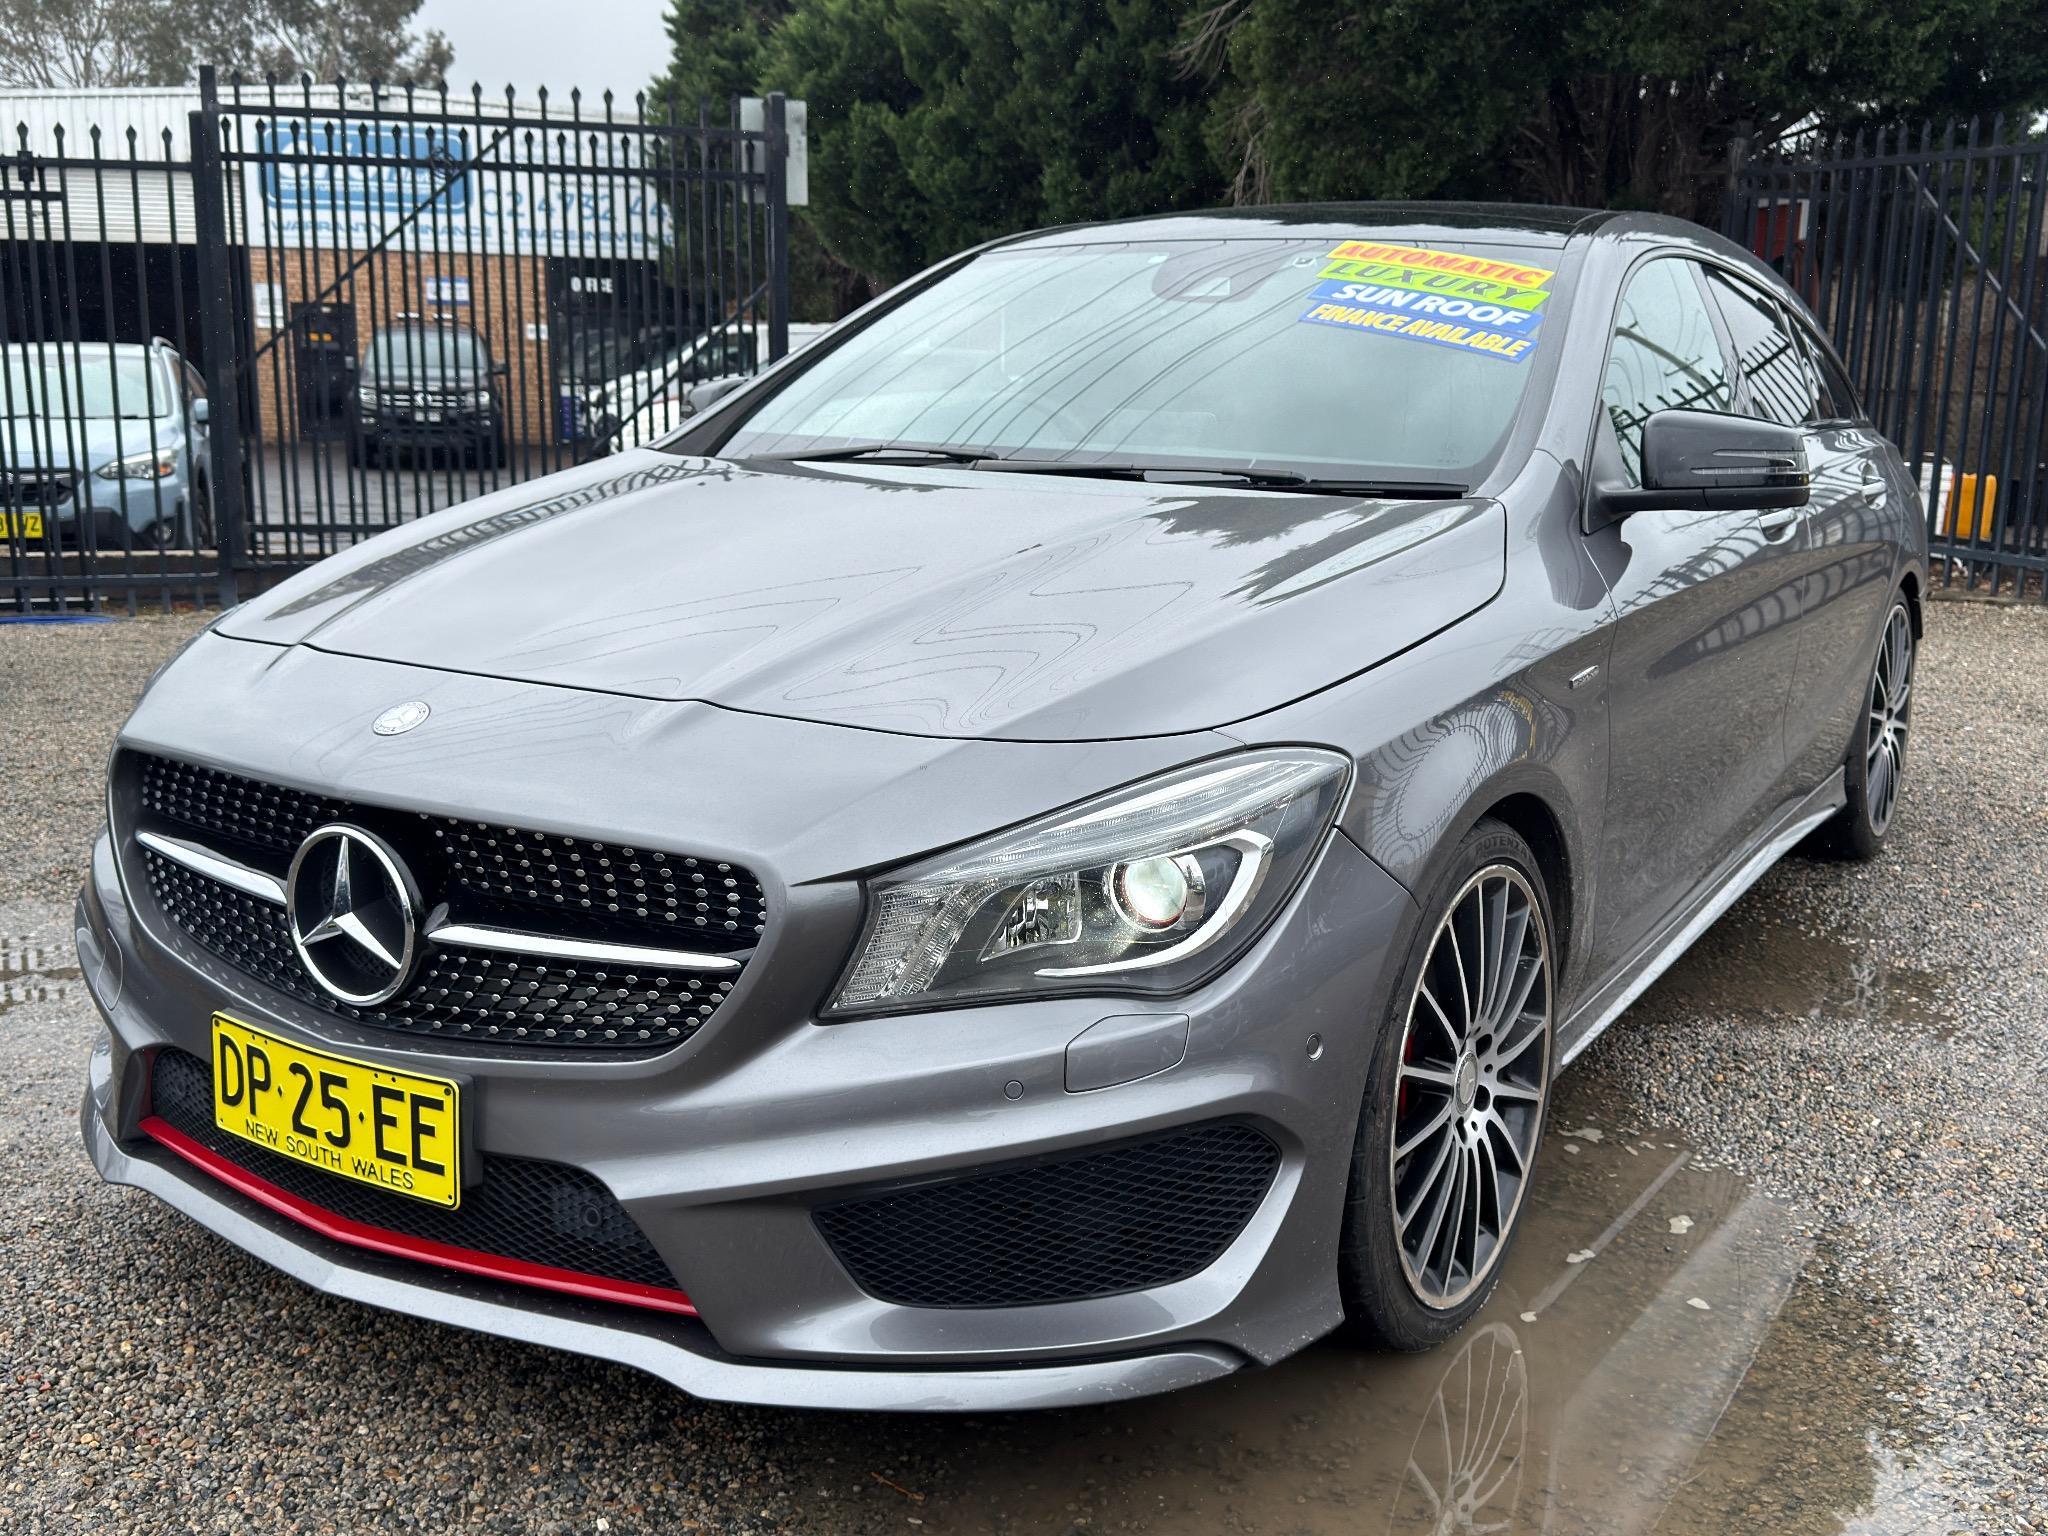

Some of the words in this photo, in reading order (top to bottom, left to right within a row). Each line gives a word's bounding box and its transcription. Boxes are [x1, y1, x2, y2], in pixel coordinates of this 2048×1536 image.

[1331, 262, 1541, 299] LUXURY
[1334, 244, 1546, 285] AUTOMATIC
[1332, 284, 1410, 308] SUN
[1413, 294, 1531, 326] ROOF
[1306, 304, 1403, 333] FINANCE
[1402, 318, 1532, 357] AVAILABLE
[245, 1118, 278, 1146] NEW
[286, 1136, 342, 1169] SOUTH
[352, 1157, 415, 1190] WALES
